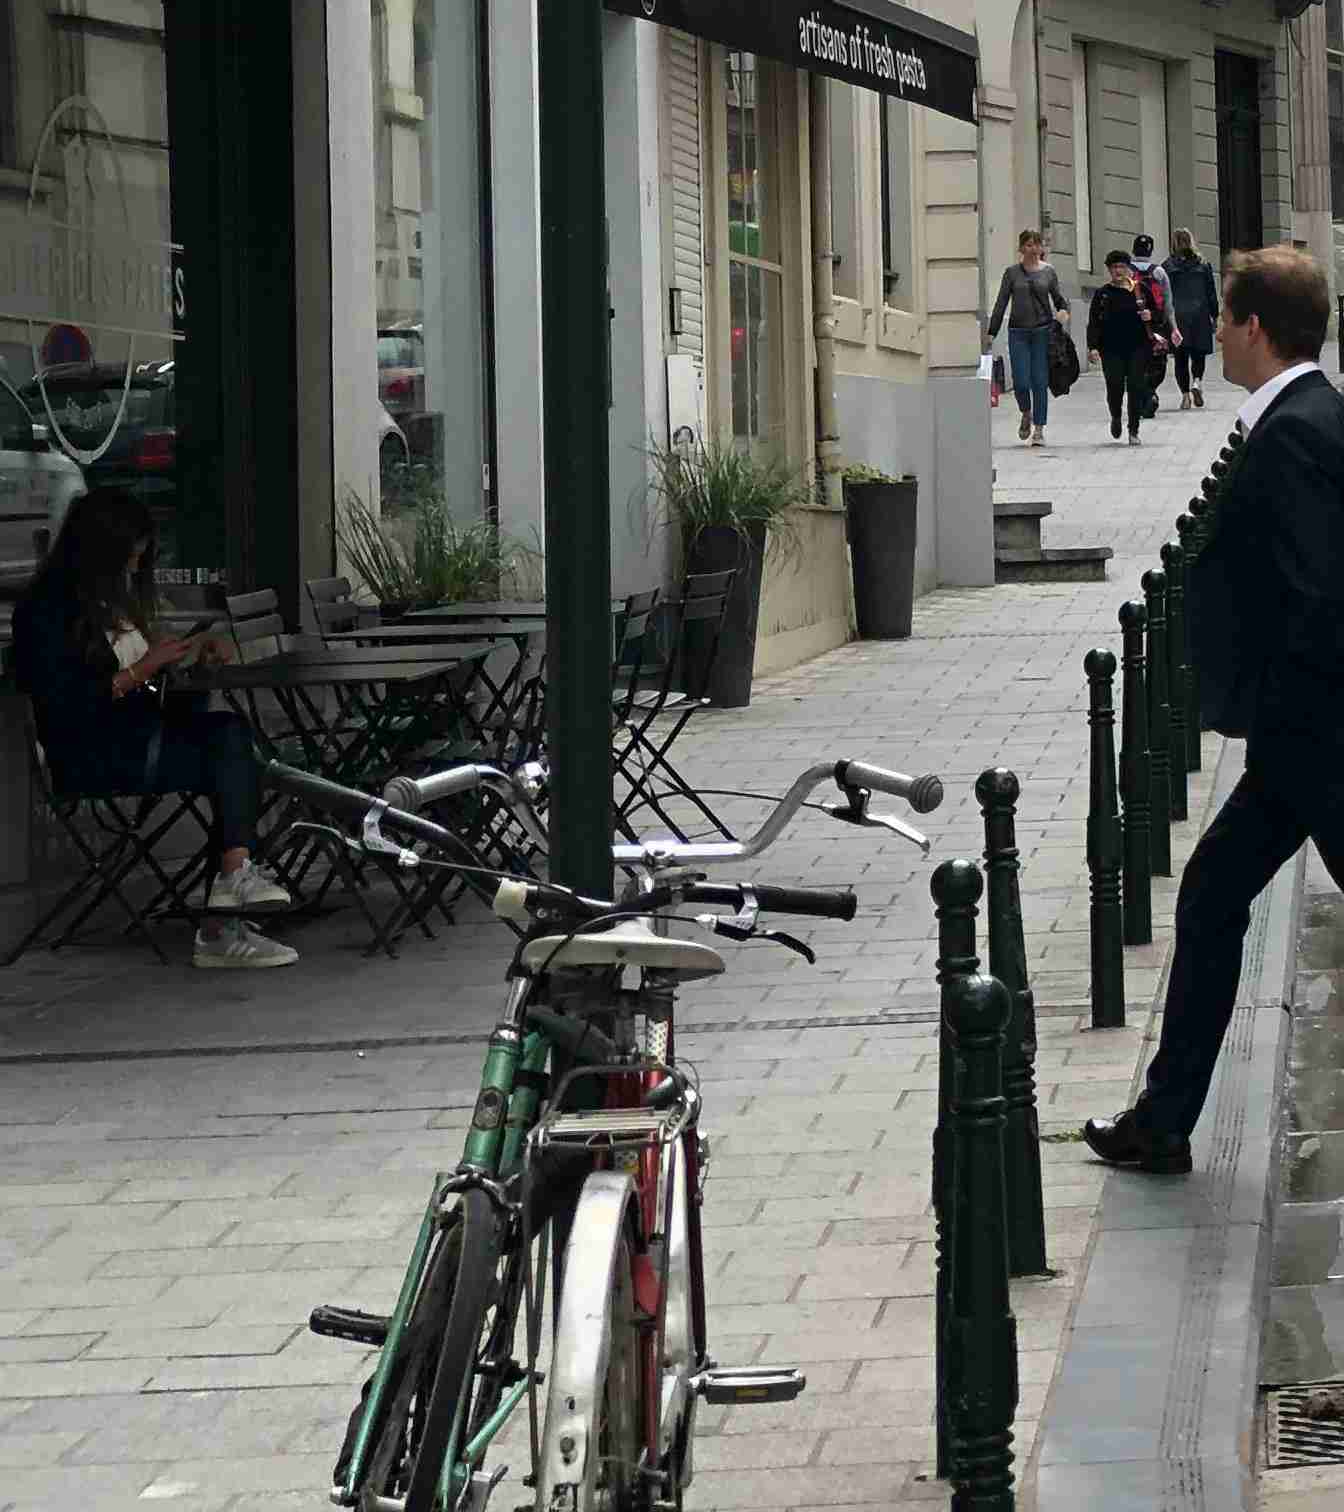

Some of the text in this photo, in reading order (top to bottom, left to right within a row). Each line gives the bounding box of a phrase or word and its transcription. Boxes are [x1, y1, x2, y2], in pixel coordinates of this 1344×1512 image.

[798, 11, 927, 96] artisans of fresh pasta
